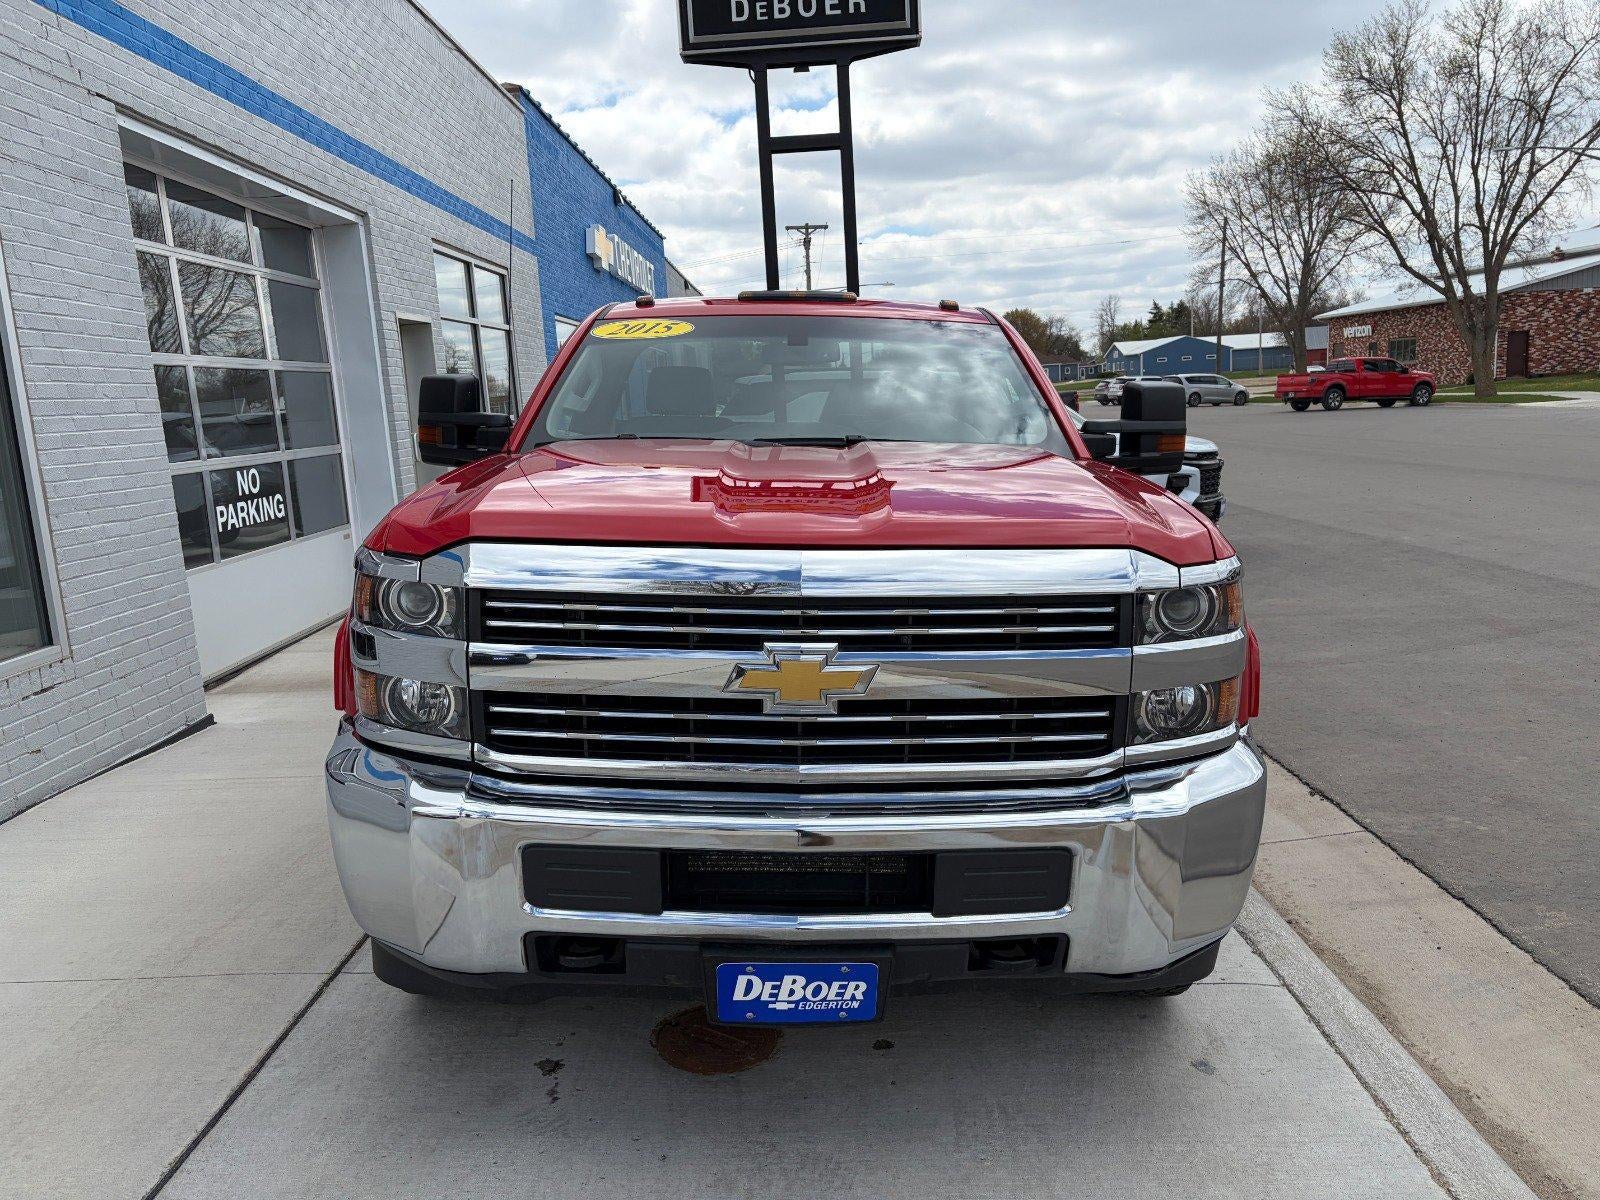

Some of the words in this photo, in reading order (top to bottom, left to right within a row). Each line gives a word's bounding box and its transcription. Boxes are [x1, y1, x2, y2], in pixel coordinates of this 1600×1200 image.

[606, 322, 680, 336] 2015
[1343, 323, 1372, 338] verizon
[236, 467, 260, 496] NO
[215, 493, 286, 533] PARKING
[798, 1000, 861, 1011] EDGERTON
